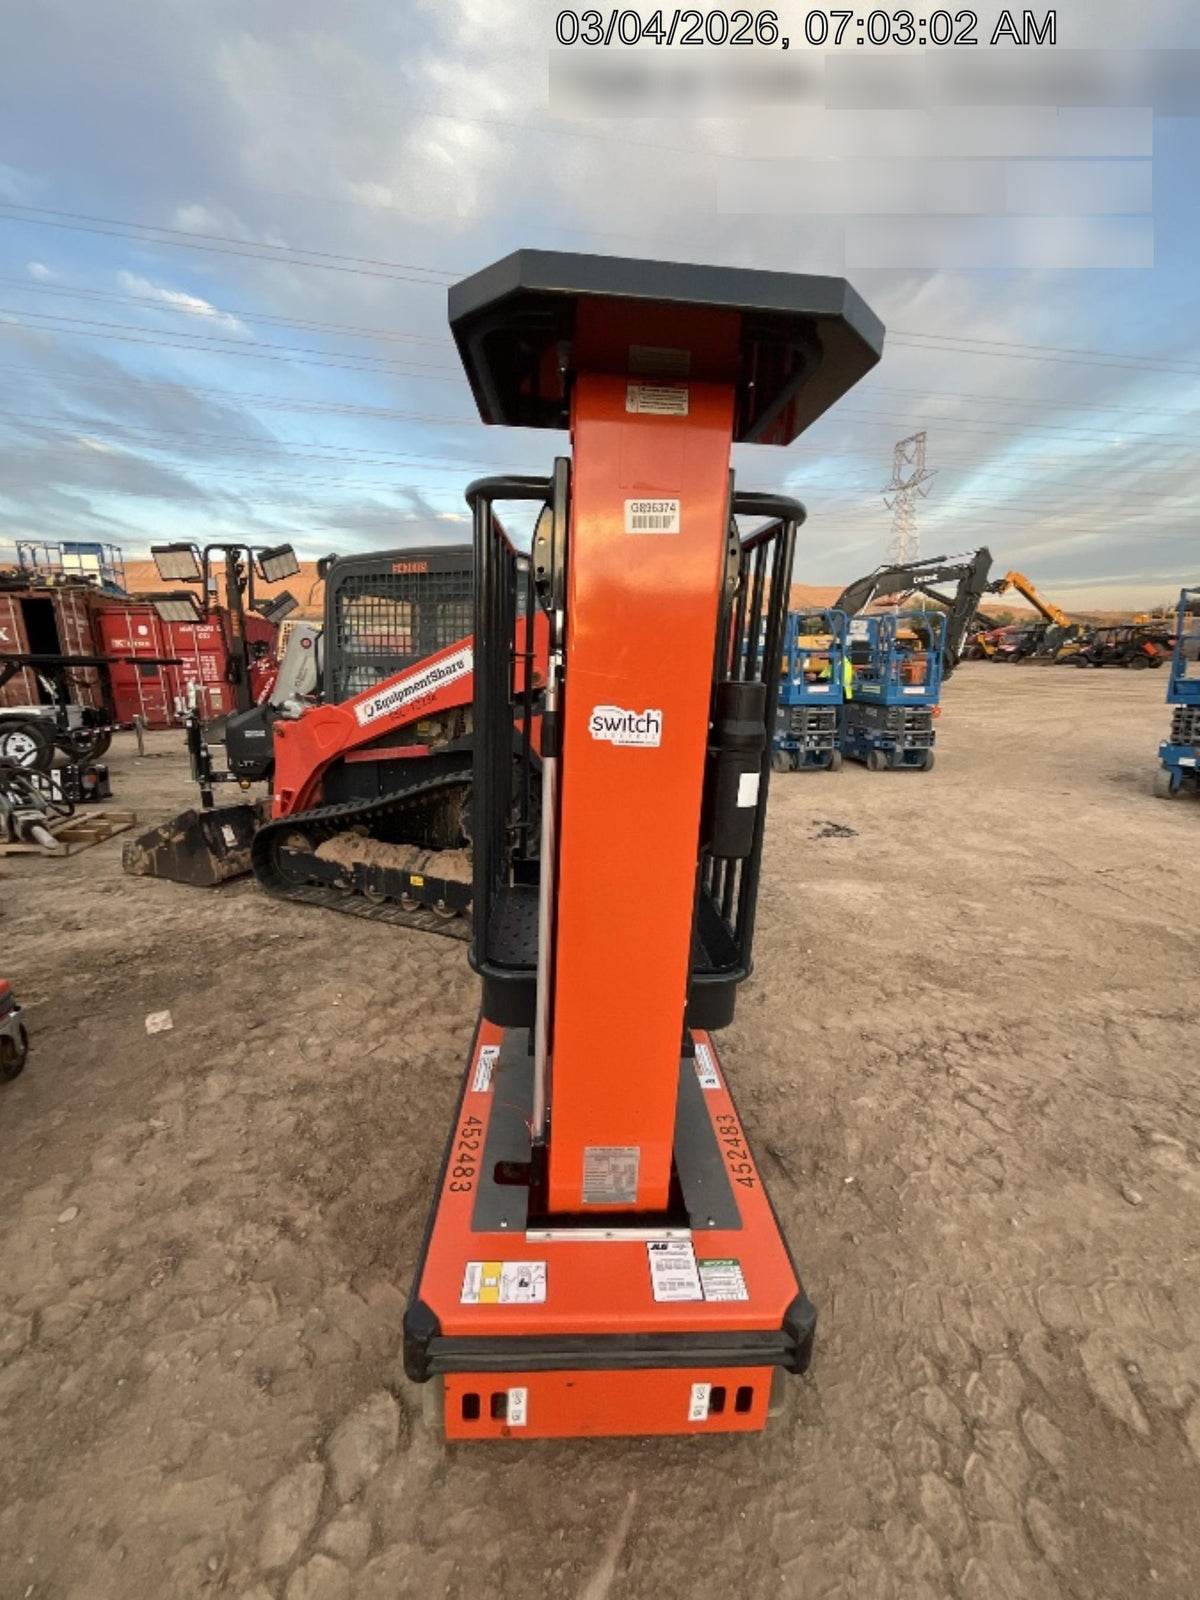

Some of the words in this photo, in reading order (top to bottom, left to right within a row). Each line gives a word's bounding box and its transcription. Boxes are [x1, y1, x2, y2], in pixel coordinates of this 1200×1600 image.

[374, 659, 465, 711] EquipmentShare
[592, 712, 659, 733] switch
[449, 1116, 483, 1192] 452483
[716, 1114, 756, 1188] 452483
